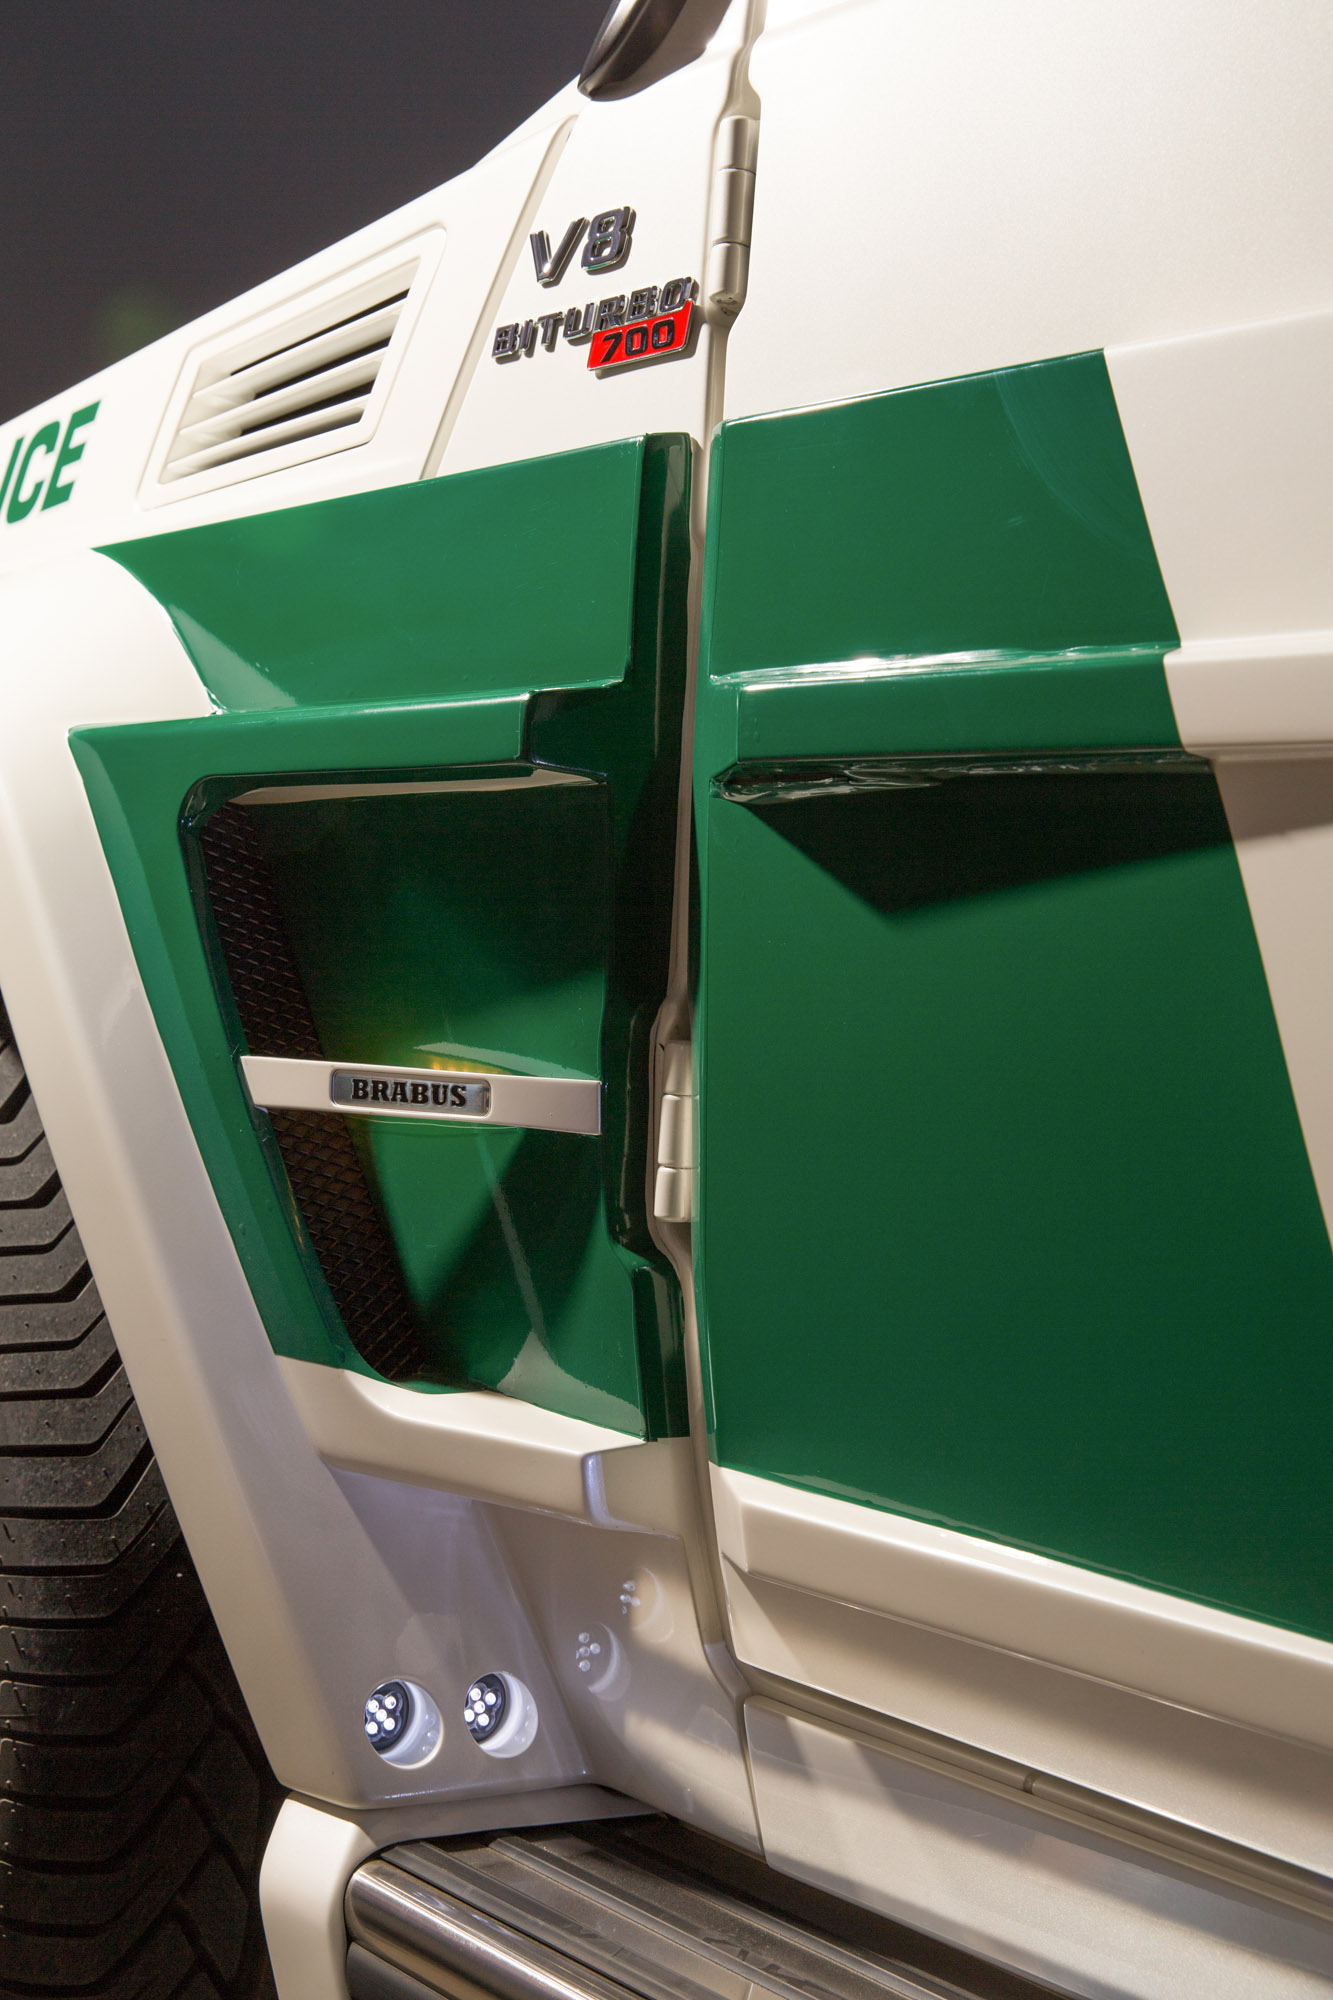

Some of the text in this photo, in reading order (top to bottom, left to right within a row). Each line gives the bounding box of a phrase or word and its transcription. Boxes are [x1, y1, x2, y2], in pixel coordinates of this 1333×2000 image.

[530, 206, 636, 285] V8
[492, 276, 696, 358] BITURBO
[600, 318, 676, 363] 700
[0, 400, 101, 524] ICE
[351, 1078, 467, 1108] BRABUS
